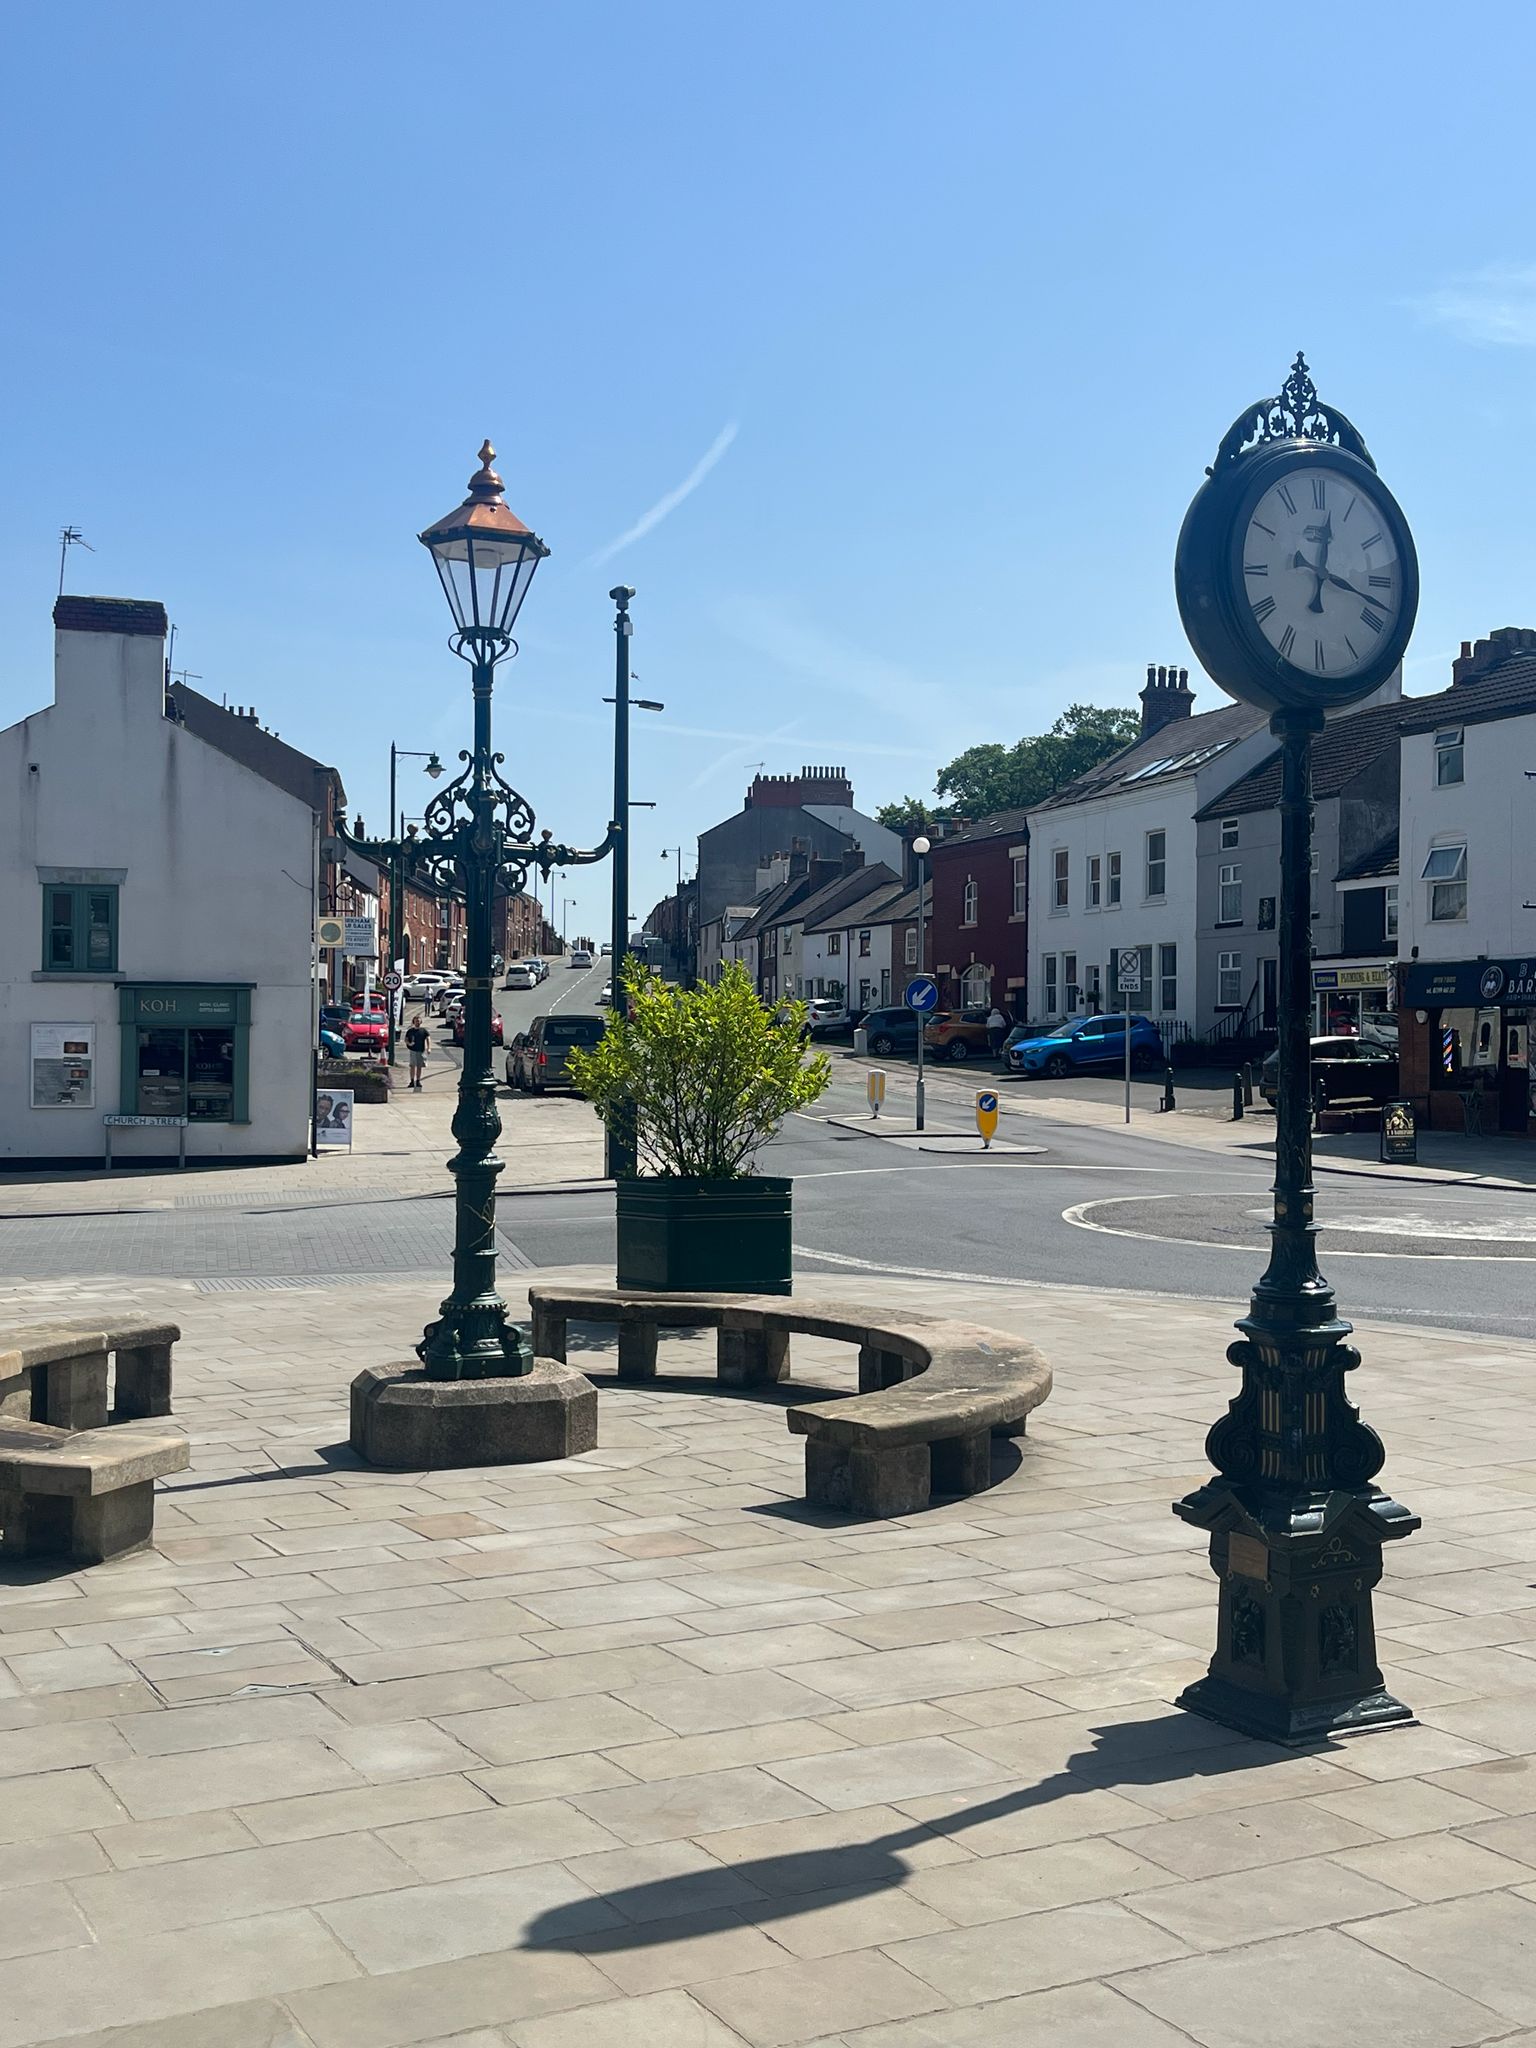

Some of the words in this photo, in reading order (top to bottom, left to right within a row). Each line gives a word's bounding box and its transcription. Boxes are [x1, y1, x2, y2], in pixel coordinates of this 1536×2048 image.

[385, 976, 398, 985] 20
[1508, 979, 1536, 993] BAR
[107, 1116, 146, 1125] CHURCH
[149, 1117, 185, 1126] STREET
